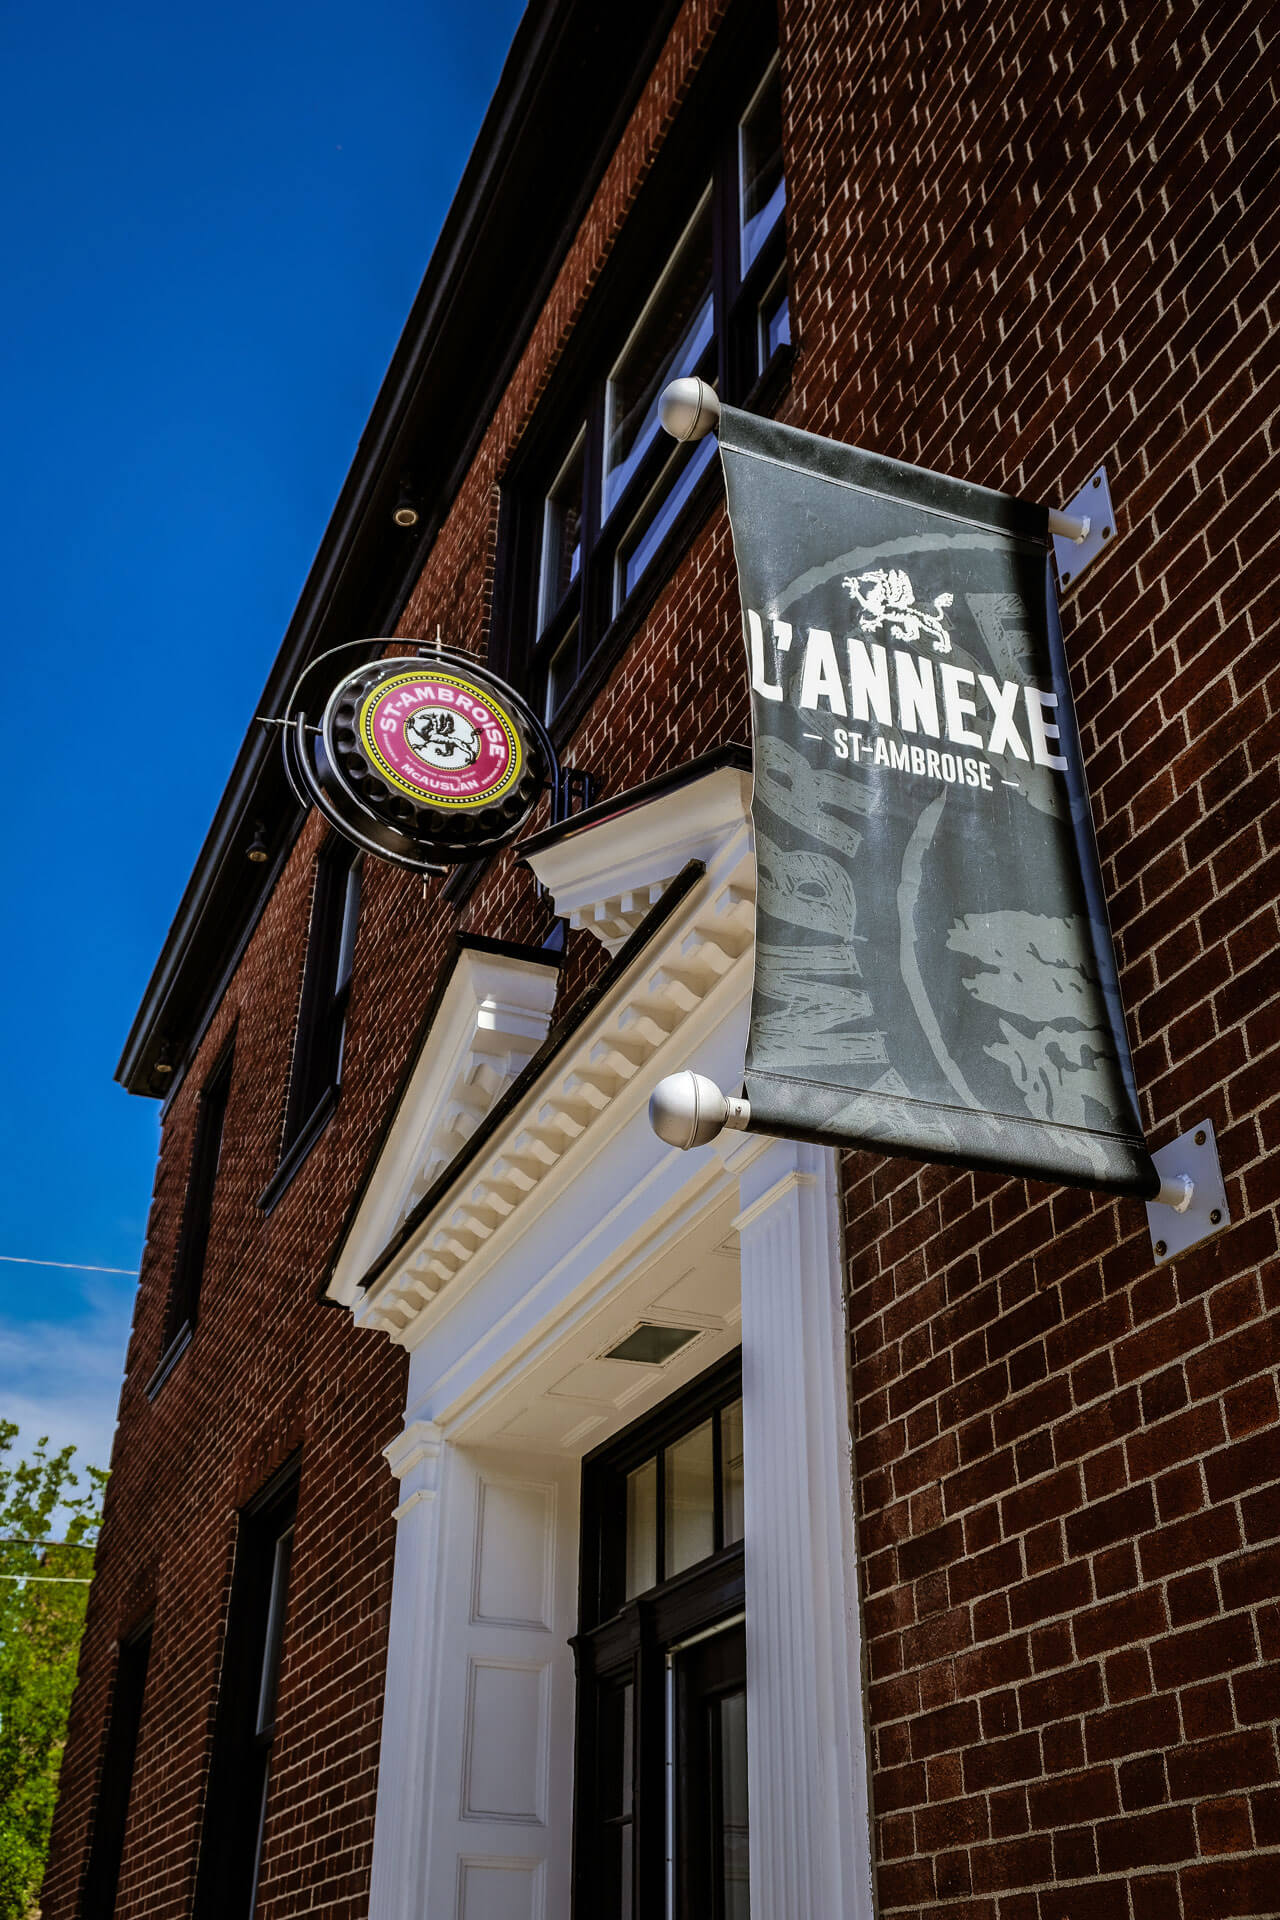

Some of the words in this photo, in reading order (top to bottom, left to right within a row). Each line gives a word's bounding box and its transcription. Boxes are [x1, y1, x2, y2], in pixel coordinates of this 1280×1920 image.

[380, 686, 505, 759] ST-AMBROISE
[748, 609, 1069, 771] L'ANNEXE
[834, 728, 994, 792] ST-AMBROISE
